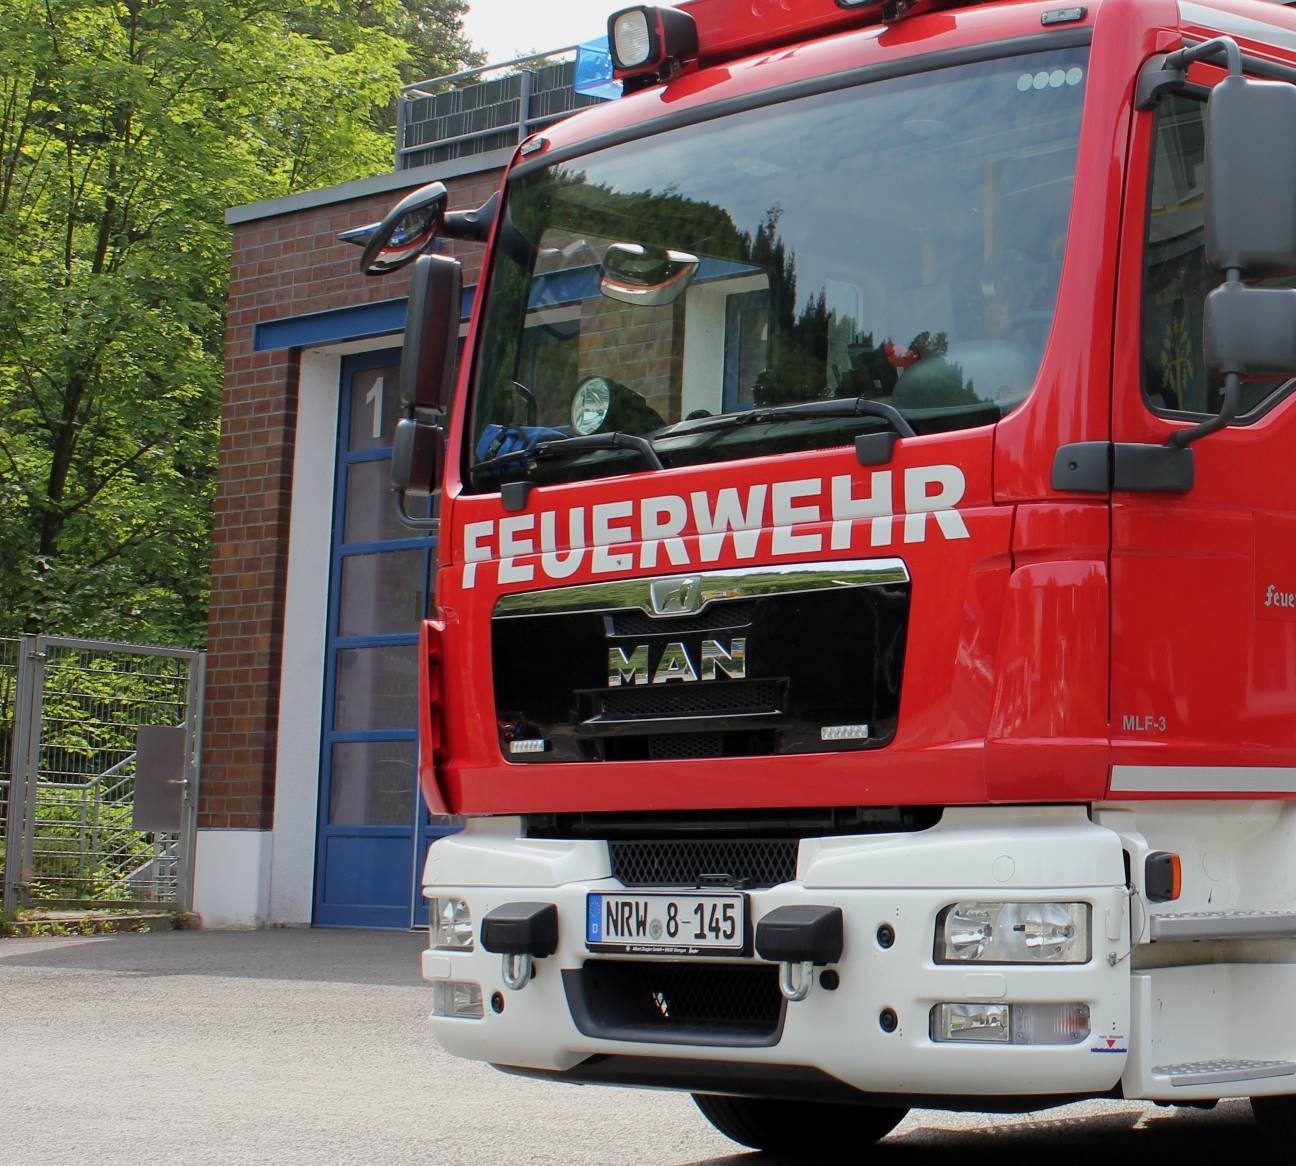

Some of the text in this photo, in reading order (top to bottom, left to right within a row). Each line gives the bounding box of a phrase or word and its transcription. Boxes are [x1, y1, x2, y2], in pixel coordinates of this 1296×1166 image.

[366, 376, 384, 438] 1
[461, 464, 970, 589] FEUERWEHR
[608, 636, 747, 688] MAN
[1122, 715, 1166, 732] MLF-3
[606, 900, 736, 939] NRW 8-145
